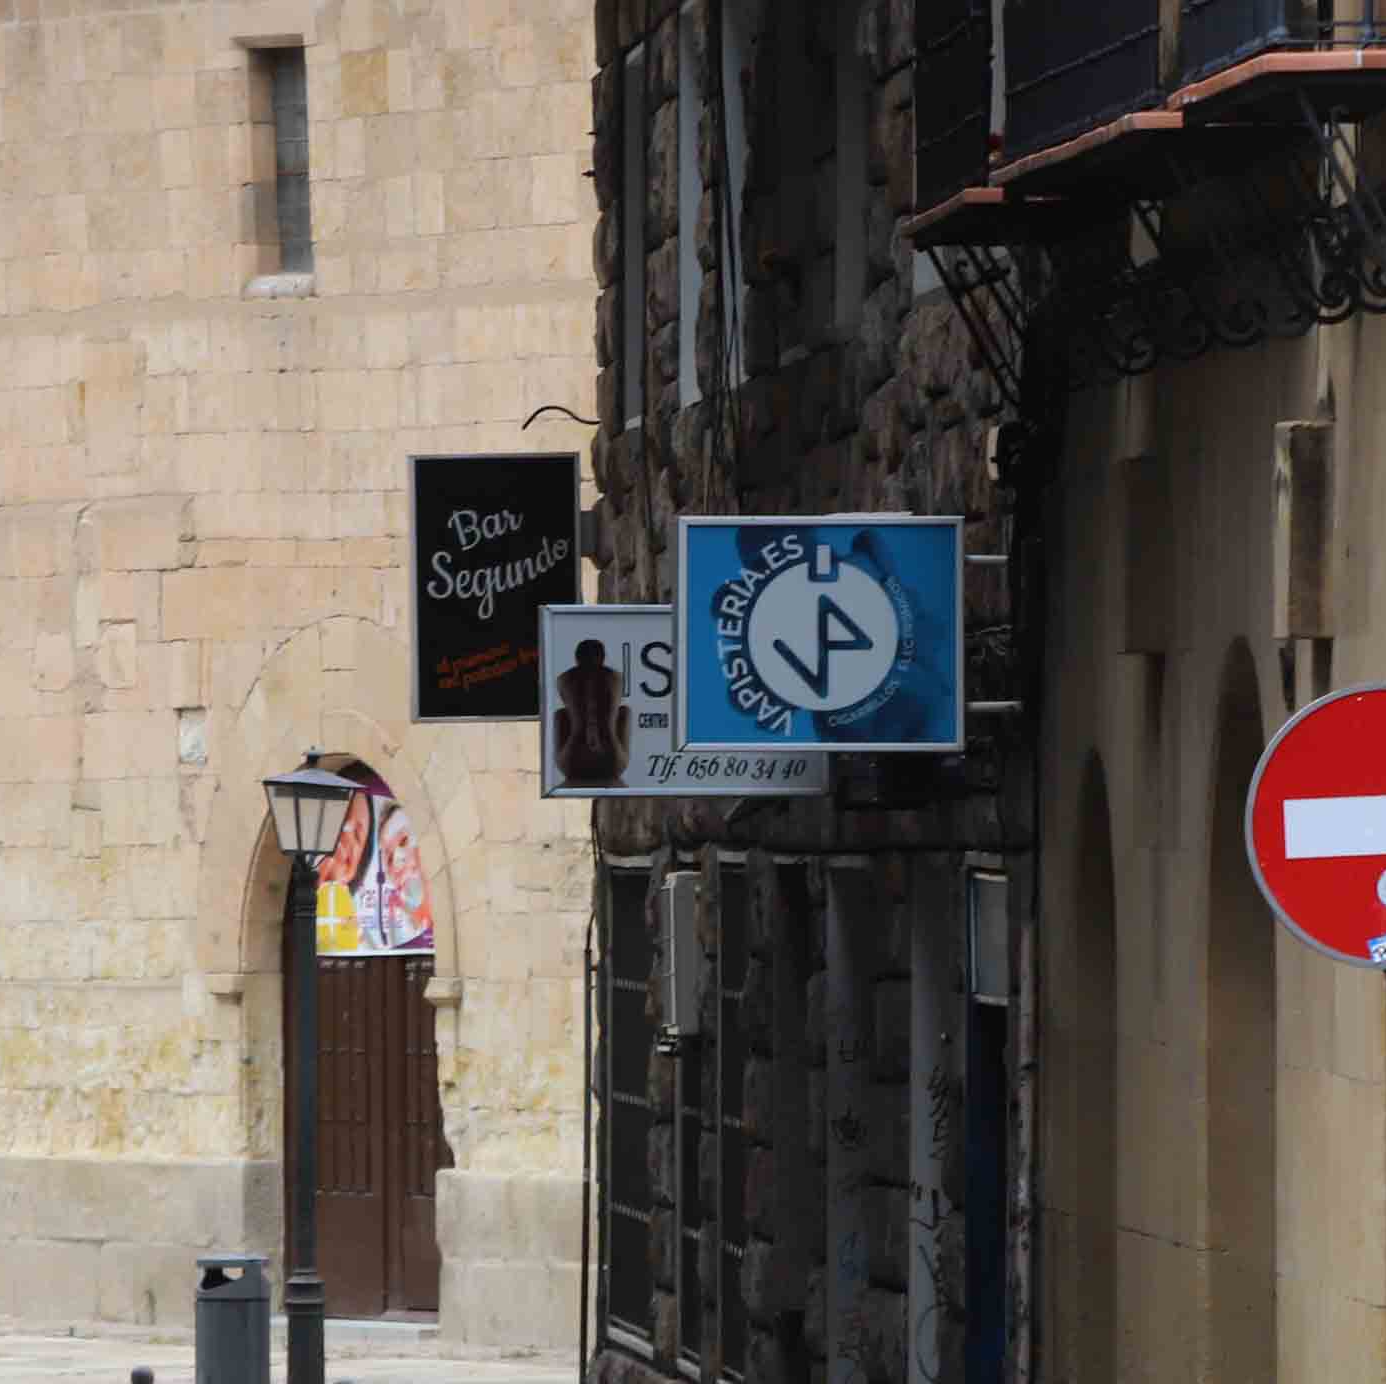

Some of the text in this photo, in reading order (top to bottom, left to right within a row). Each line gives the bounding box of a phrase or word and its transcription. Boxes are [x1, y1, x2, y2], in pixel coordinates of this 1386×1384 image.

[447, 509, 524, 551] Bar
[426, 536, 571, 620] Segundo
[647, 754, 806, 784] Tlf. 656 80 34 40
